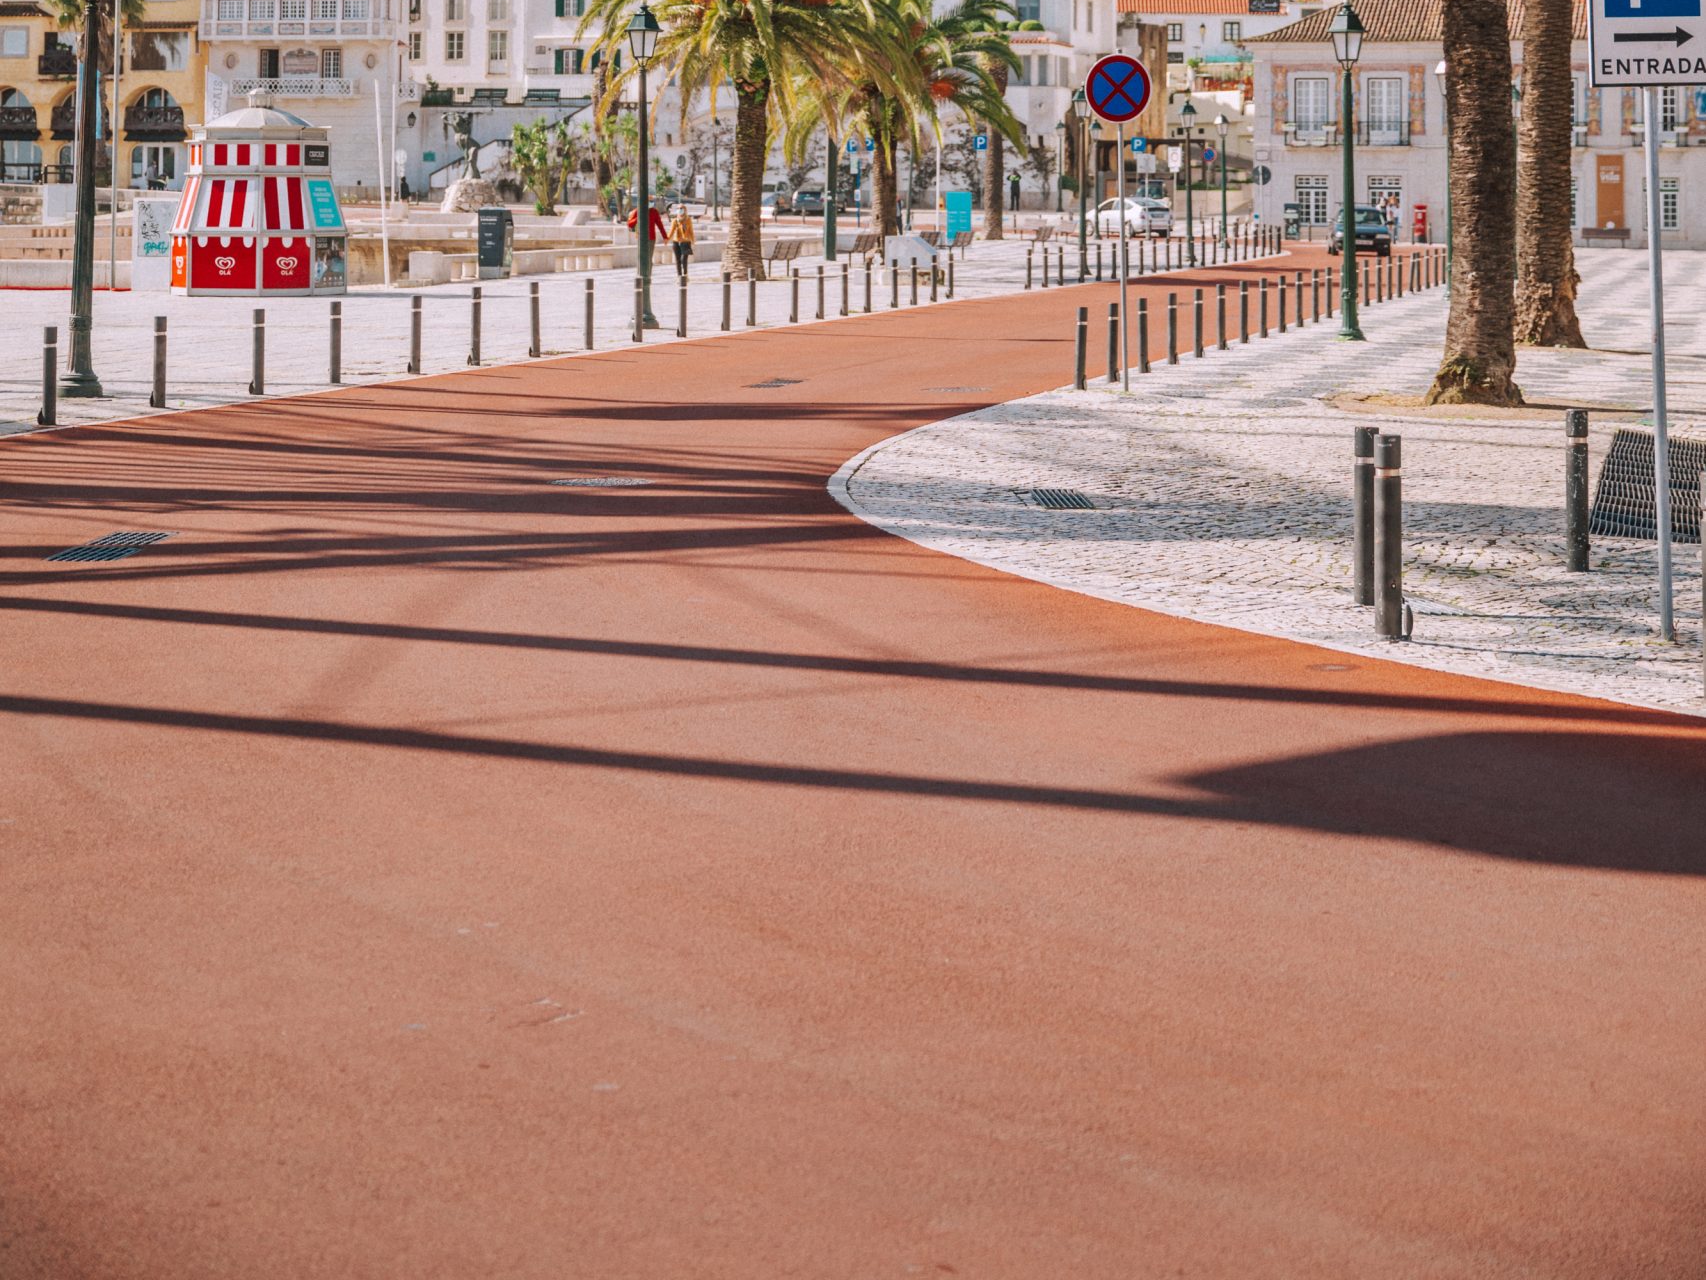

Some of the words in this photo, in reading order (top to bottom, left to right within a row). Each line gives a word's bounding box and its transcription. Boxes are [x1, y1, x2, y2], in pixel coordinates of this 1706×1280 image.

[1601, 58, 1706, 75] ENTRADA
[976, 137, 986, 148] P
[1133, 139, 1142, 149] P
